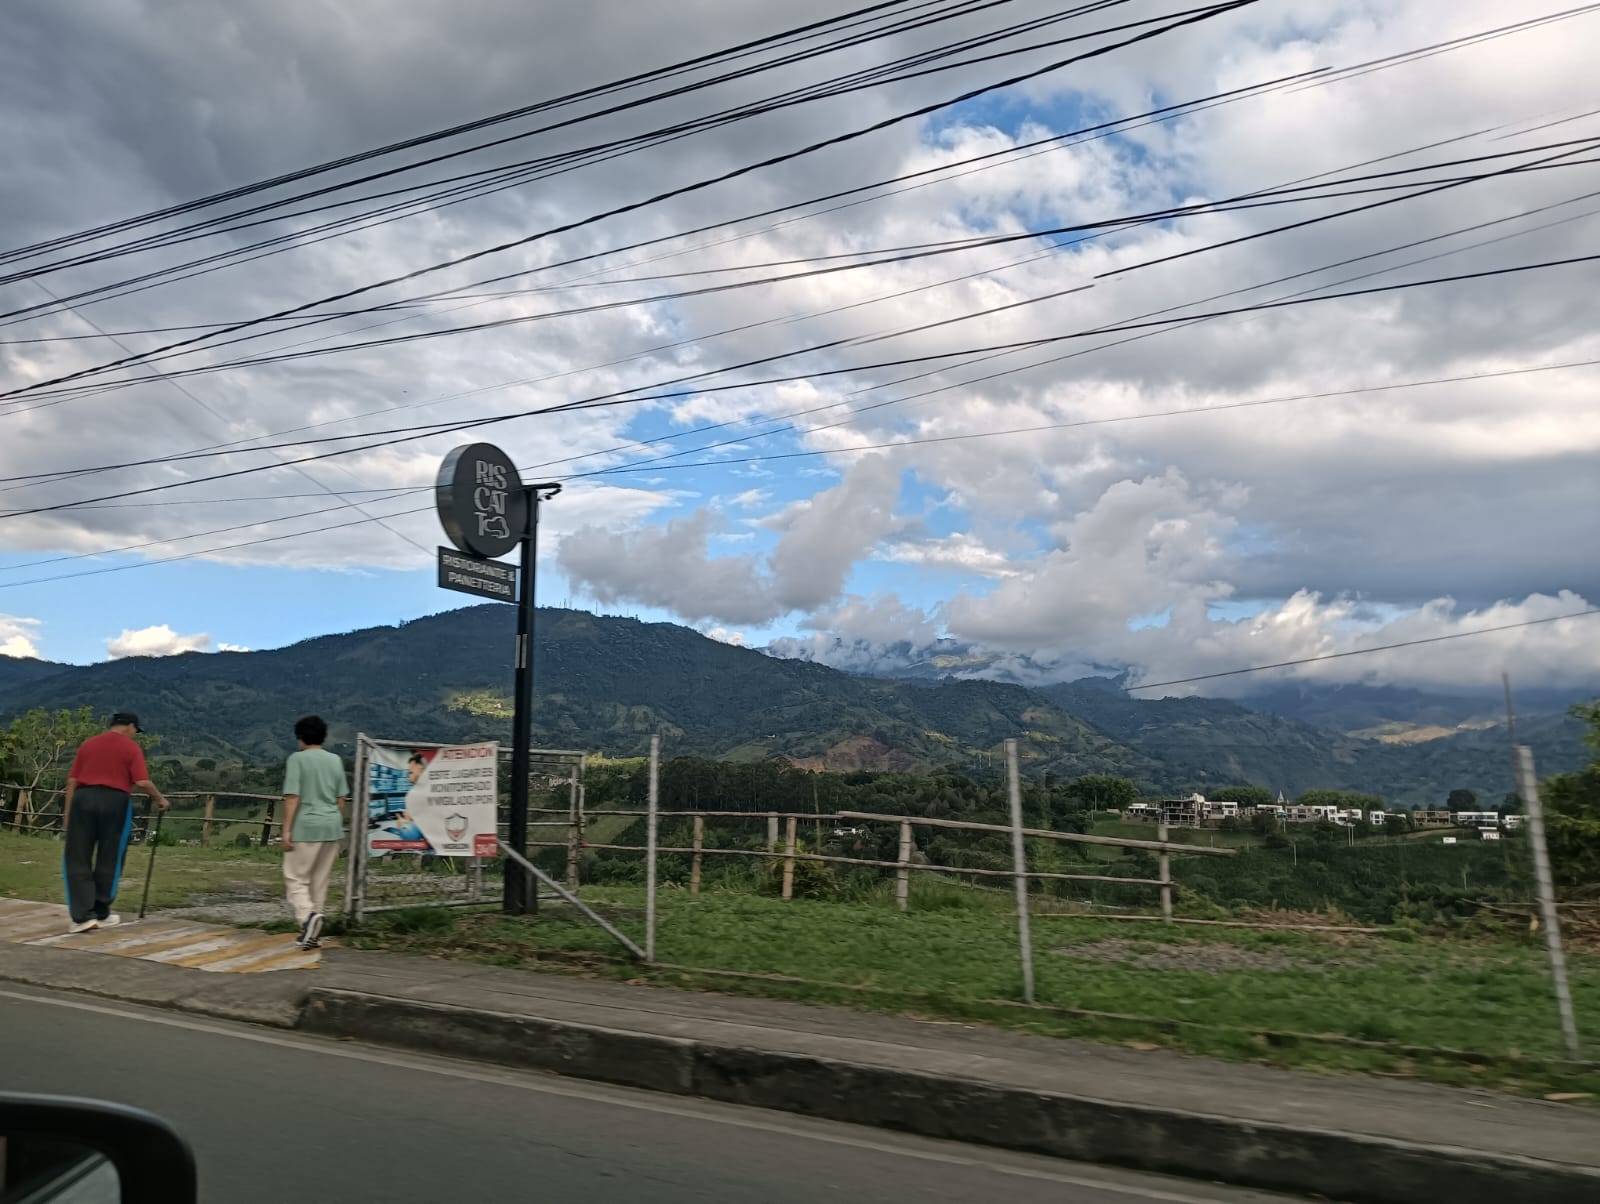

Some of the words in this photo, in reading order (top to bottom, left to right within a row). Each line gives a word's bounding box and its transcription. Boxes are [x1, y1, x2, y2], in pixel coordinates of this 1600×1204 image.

[476, 460, 508, 489] RIS
[474, 487, 509, 514] CAT
[442, 555, 507, 580] RISTORANTE
